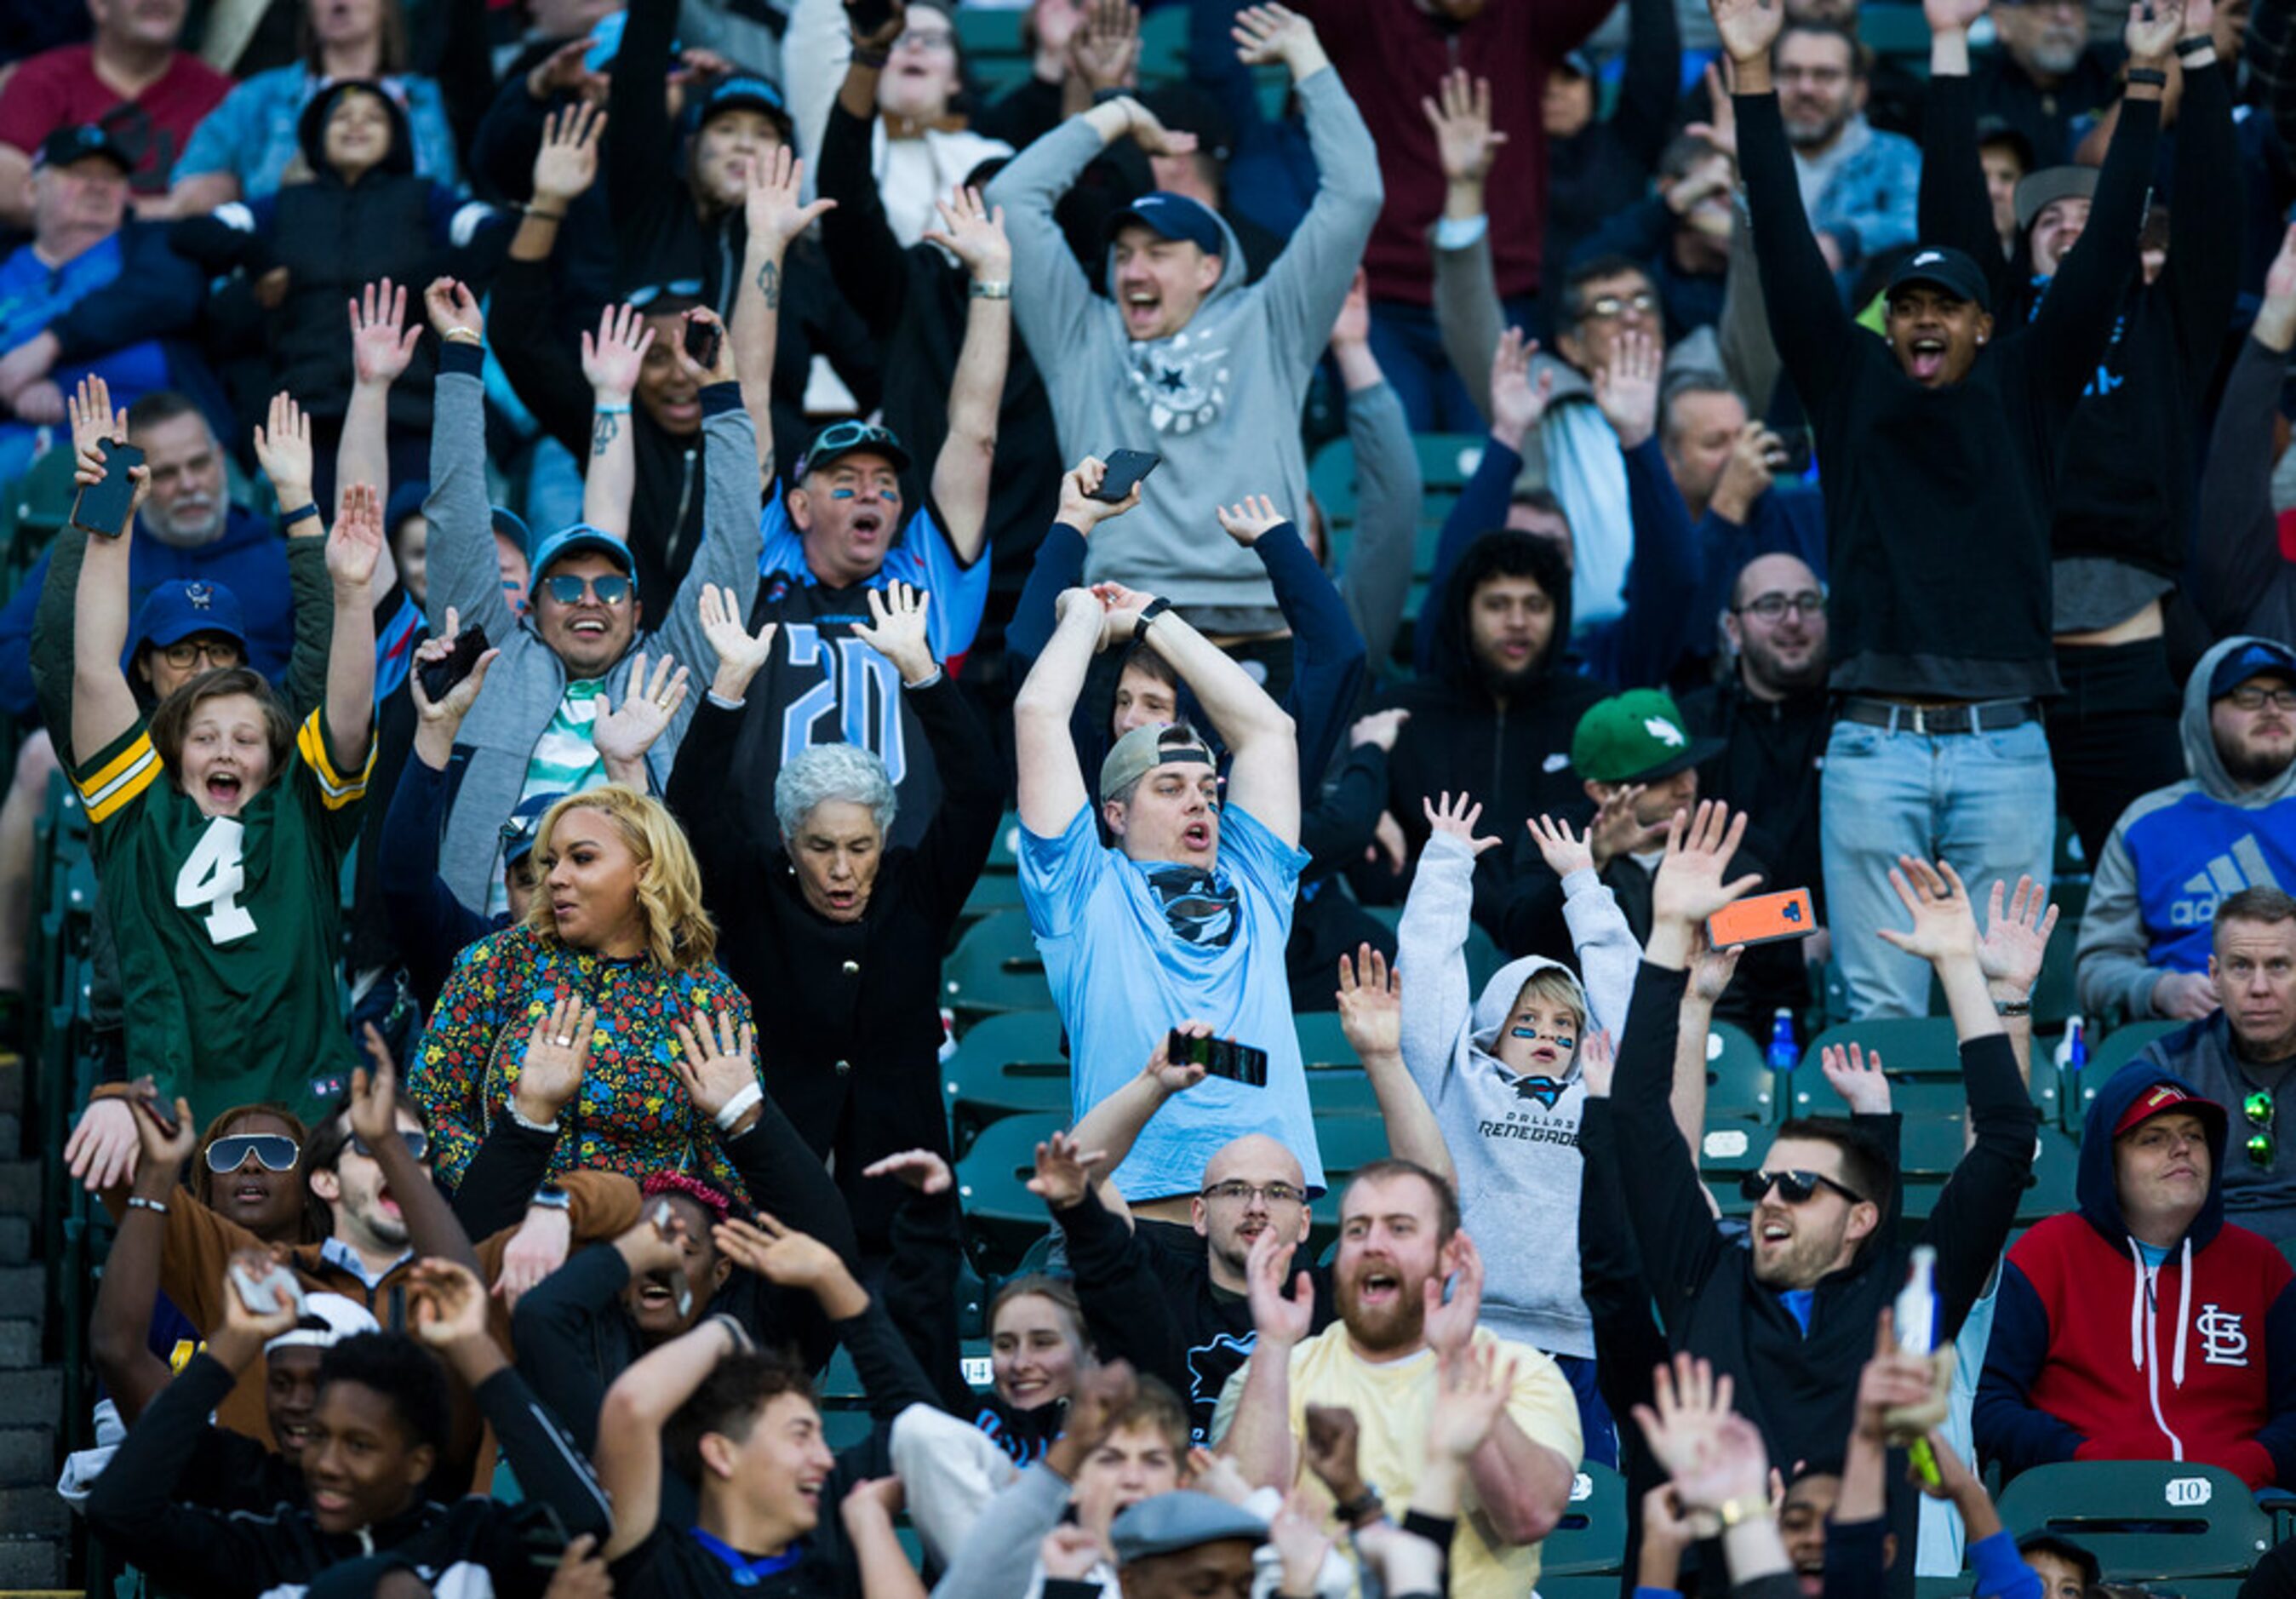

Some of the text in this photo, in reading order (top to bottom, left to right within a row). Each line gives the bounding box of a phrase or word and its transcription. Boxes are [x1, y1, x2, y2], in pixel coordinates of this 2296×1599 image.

[782, 622, 906, 786] 20
[175, 815, 258, 945] 4
[1506, 1111, 1575, 1130] DALLAS
[1479, 1120, 1580, 1147] RENEGADE
[965, 1362, 986, 1379] 14
[2179, 1482, 2201, 1500] 10
